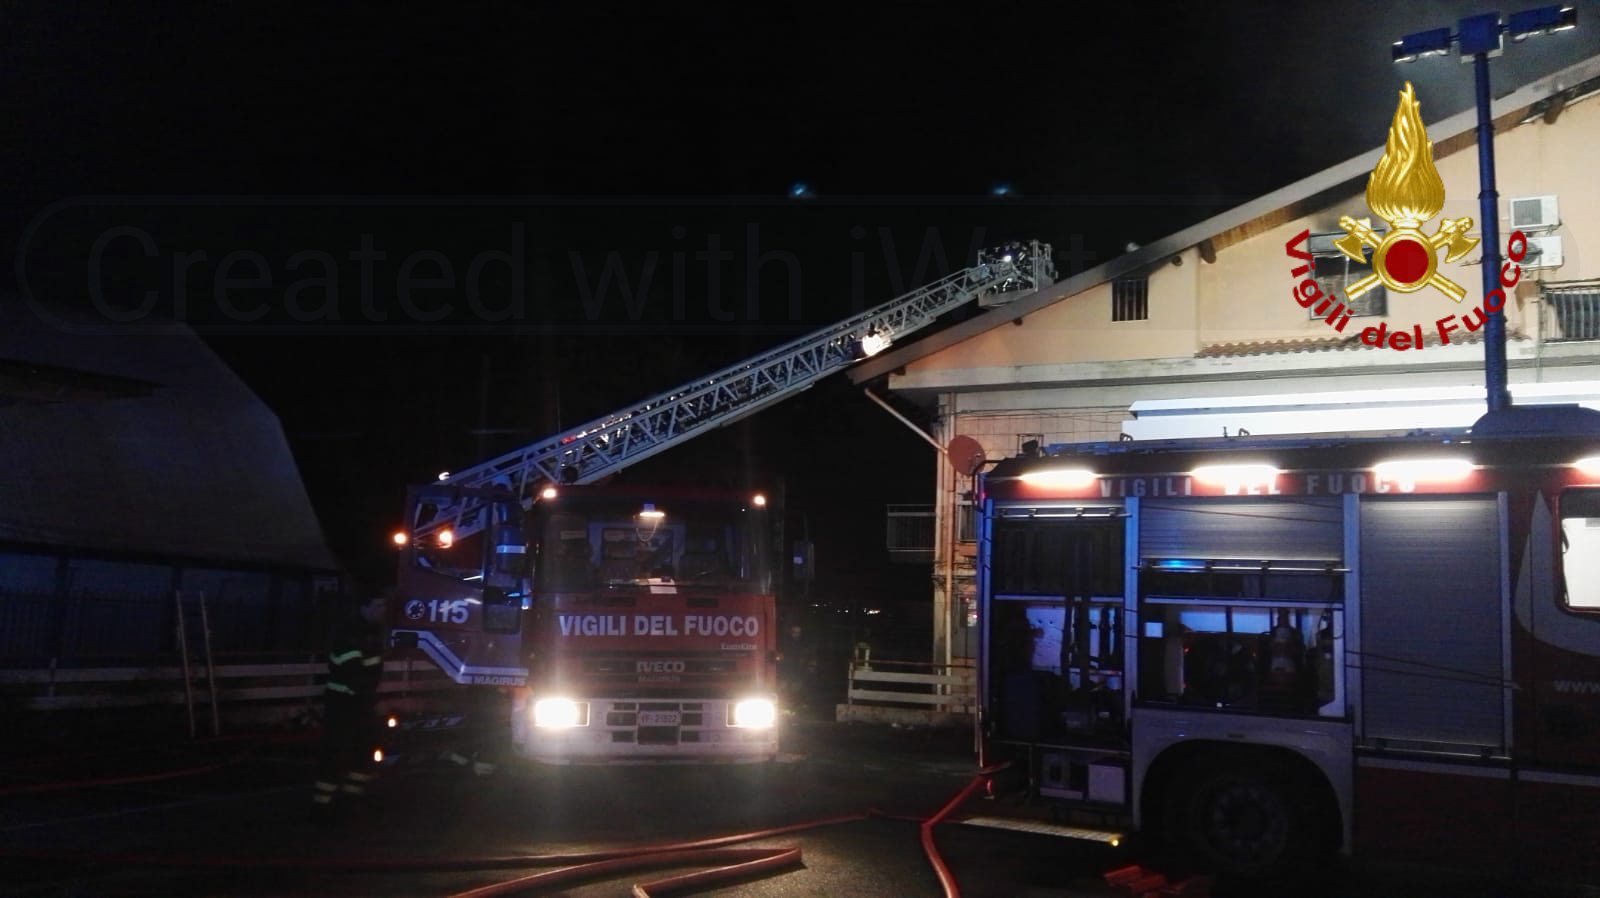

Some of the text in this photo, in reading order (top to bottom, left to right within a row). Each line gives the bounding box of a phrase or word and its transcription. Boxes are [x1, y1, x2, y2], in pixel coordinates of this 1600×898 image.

[1100, 476, 1192, 498] VIGILI
[427, 599, 470, 624] 115
[558, 614, 760, 637] VIGILI DEL FUOCO
[636, 660, 686, 673] IVECO
